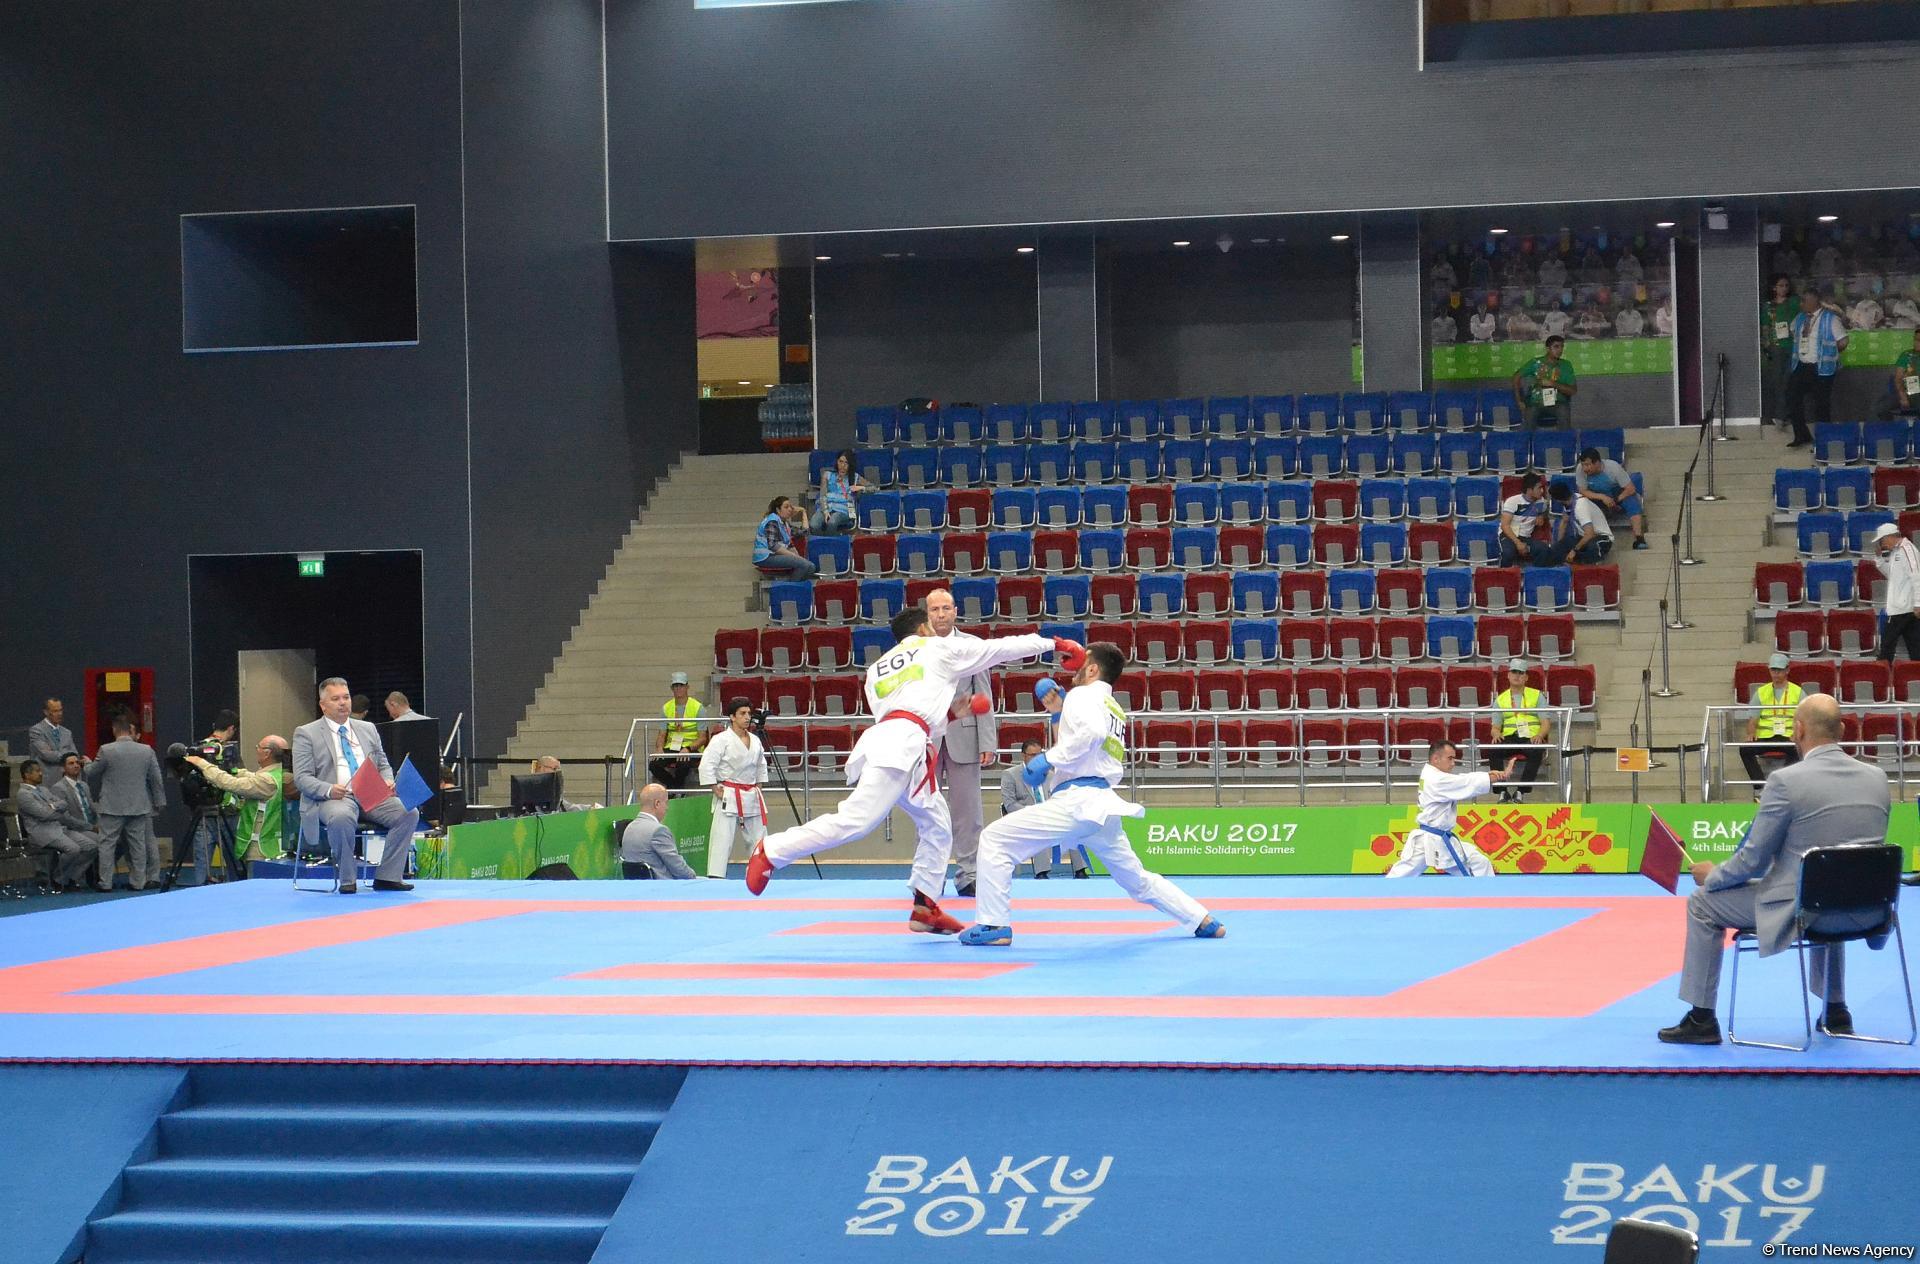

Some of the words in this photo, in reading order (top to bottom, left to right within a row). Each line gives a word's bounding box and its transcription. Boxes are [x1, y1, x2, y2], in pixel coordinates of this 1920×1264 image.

[876, 649, 919, 677] EGY
[1148, 824, 1220, 842] BAKU
[1227, 823, 1298, 842] 2017
[1692, 820, 1753, 839] BAK
[1146, 845, 1163, 855] 4th
[1166, 845, 1201, 855] Islamic
[1204, 845, 1257, 856] Solidarity
[1259, 845, 1295, 854] Games
[1692, 842, 1710, 852] 4th
[864, 1155, 1114, 1195] BAKU
[1562, 1162, 1826, 1204] BAKU
[845, 1195, 1095, 1237] 2017
